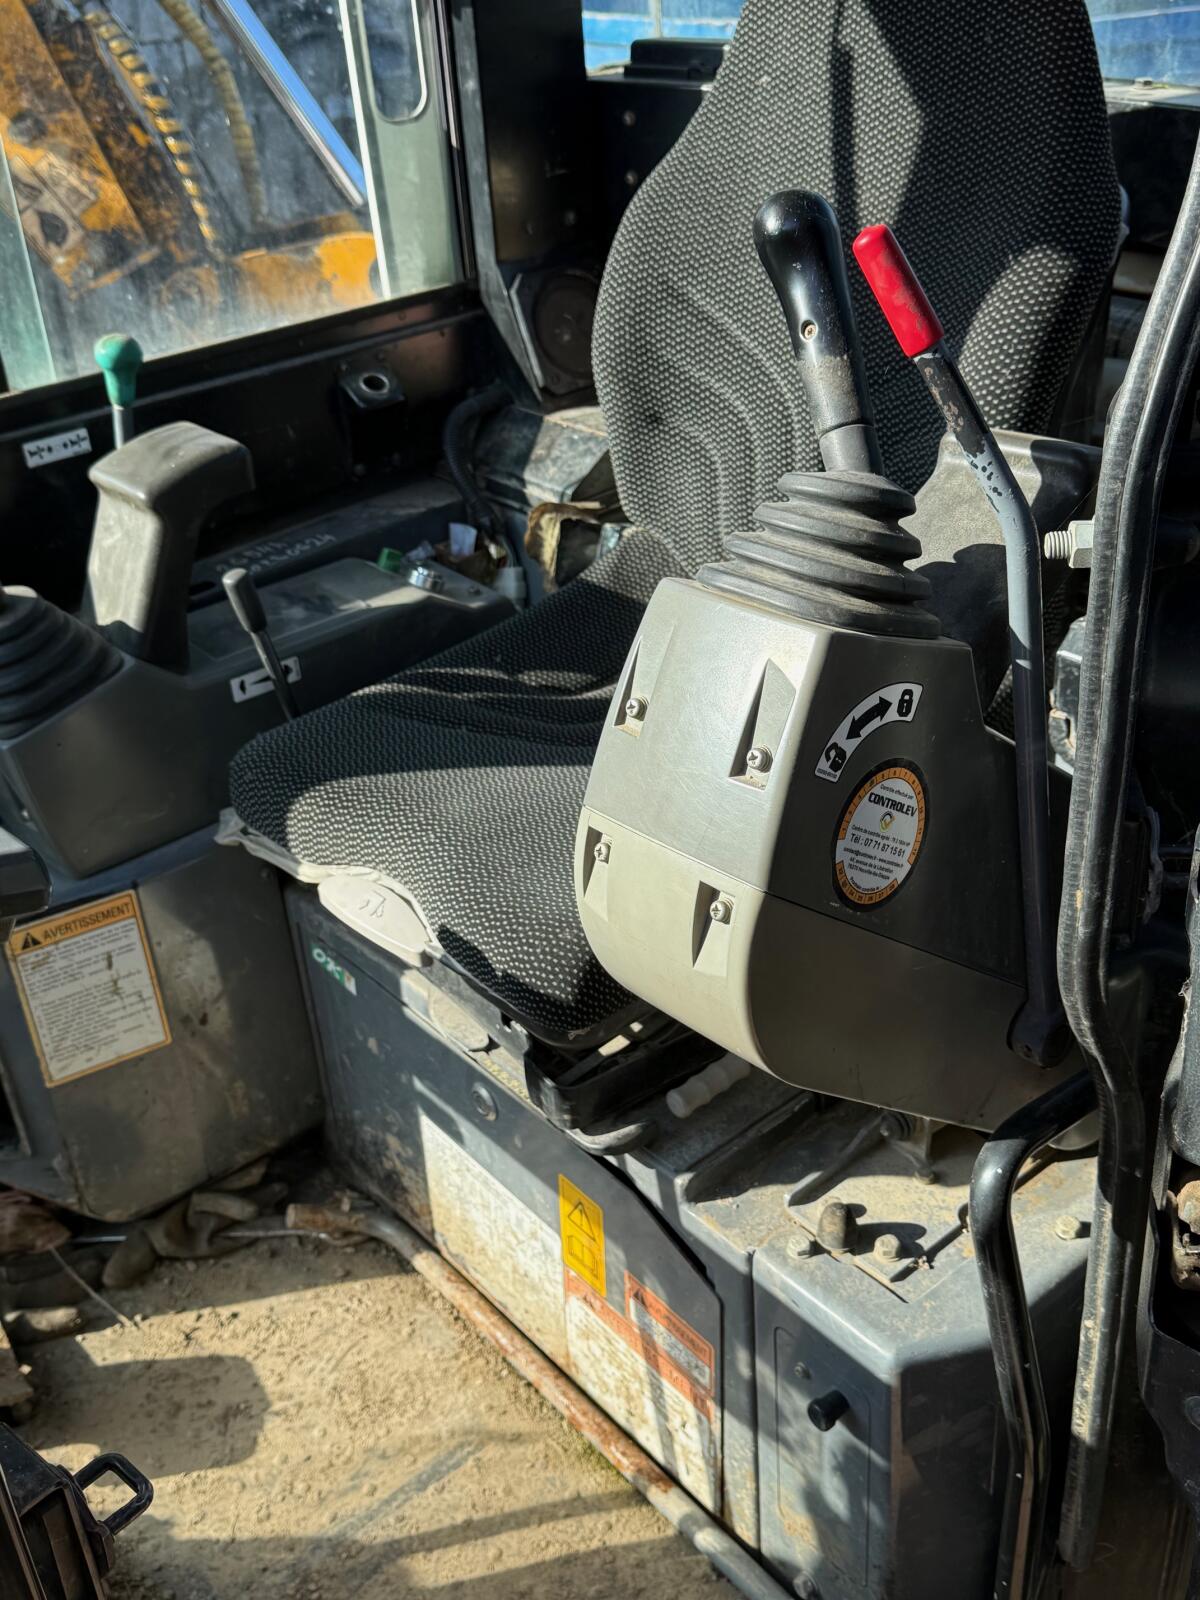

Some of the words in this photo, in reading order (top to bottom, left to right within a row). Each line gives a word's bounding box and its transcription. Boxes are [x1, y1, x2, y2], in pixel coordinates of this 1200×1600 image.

[868, 792, 917, 817] CONTROLEV
[864, 838, 873, 848] 07
[873, 841, 881, 851] 71
[881, 843, 890, 853] 87
[890, 845, 897, 856] 15
[897, 848, 905, 858] 61
[44, 903, 131, 940] AVERTISSEMENT
